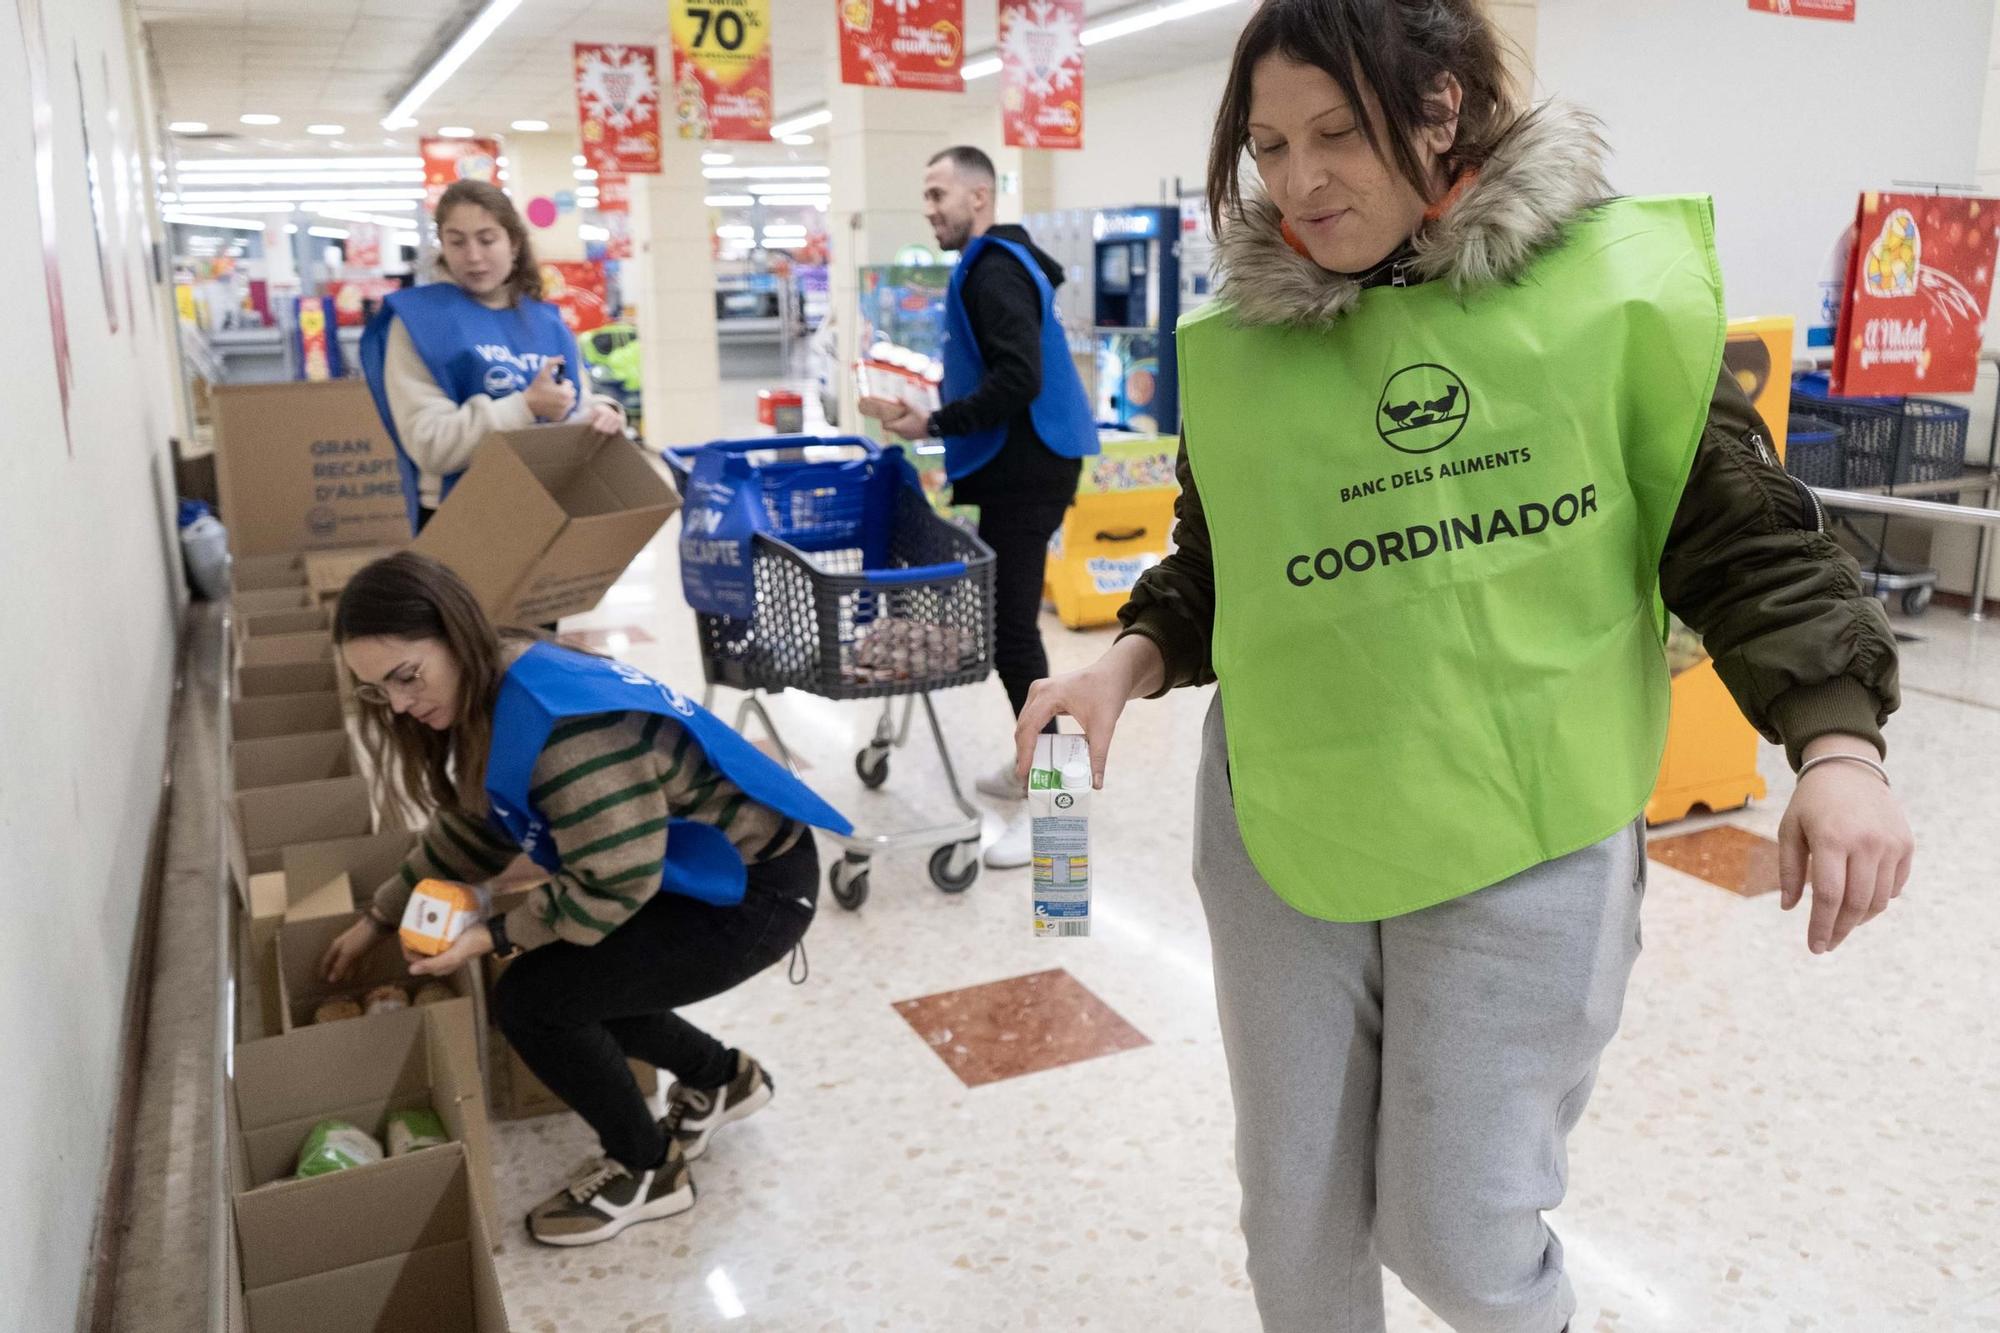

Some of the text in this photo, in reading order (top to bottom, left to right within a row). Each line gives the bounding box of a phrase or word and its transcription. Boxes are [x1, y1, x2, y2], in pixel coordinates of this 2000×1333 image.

[686, 8, 761, 51] 70%
[310, 439, 371, 456] GRAN
[313, 459, 396, 477] RECAPT
[1340, 447, 1532, 503] BANC DELS ALIMENTS
[316, 481, 402, 501] D'ALIME
[1286, 483, 1598, 587] COORDINADOR
